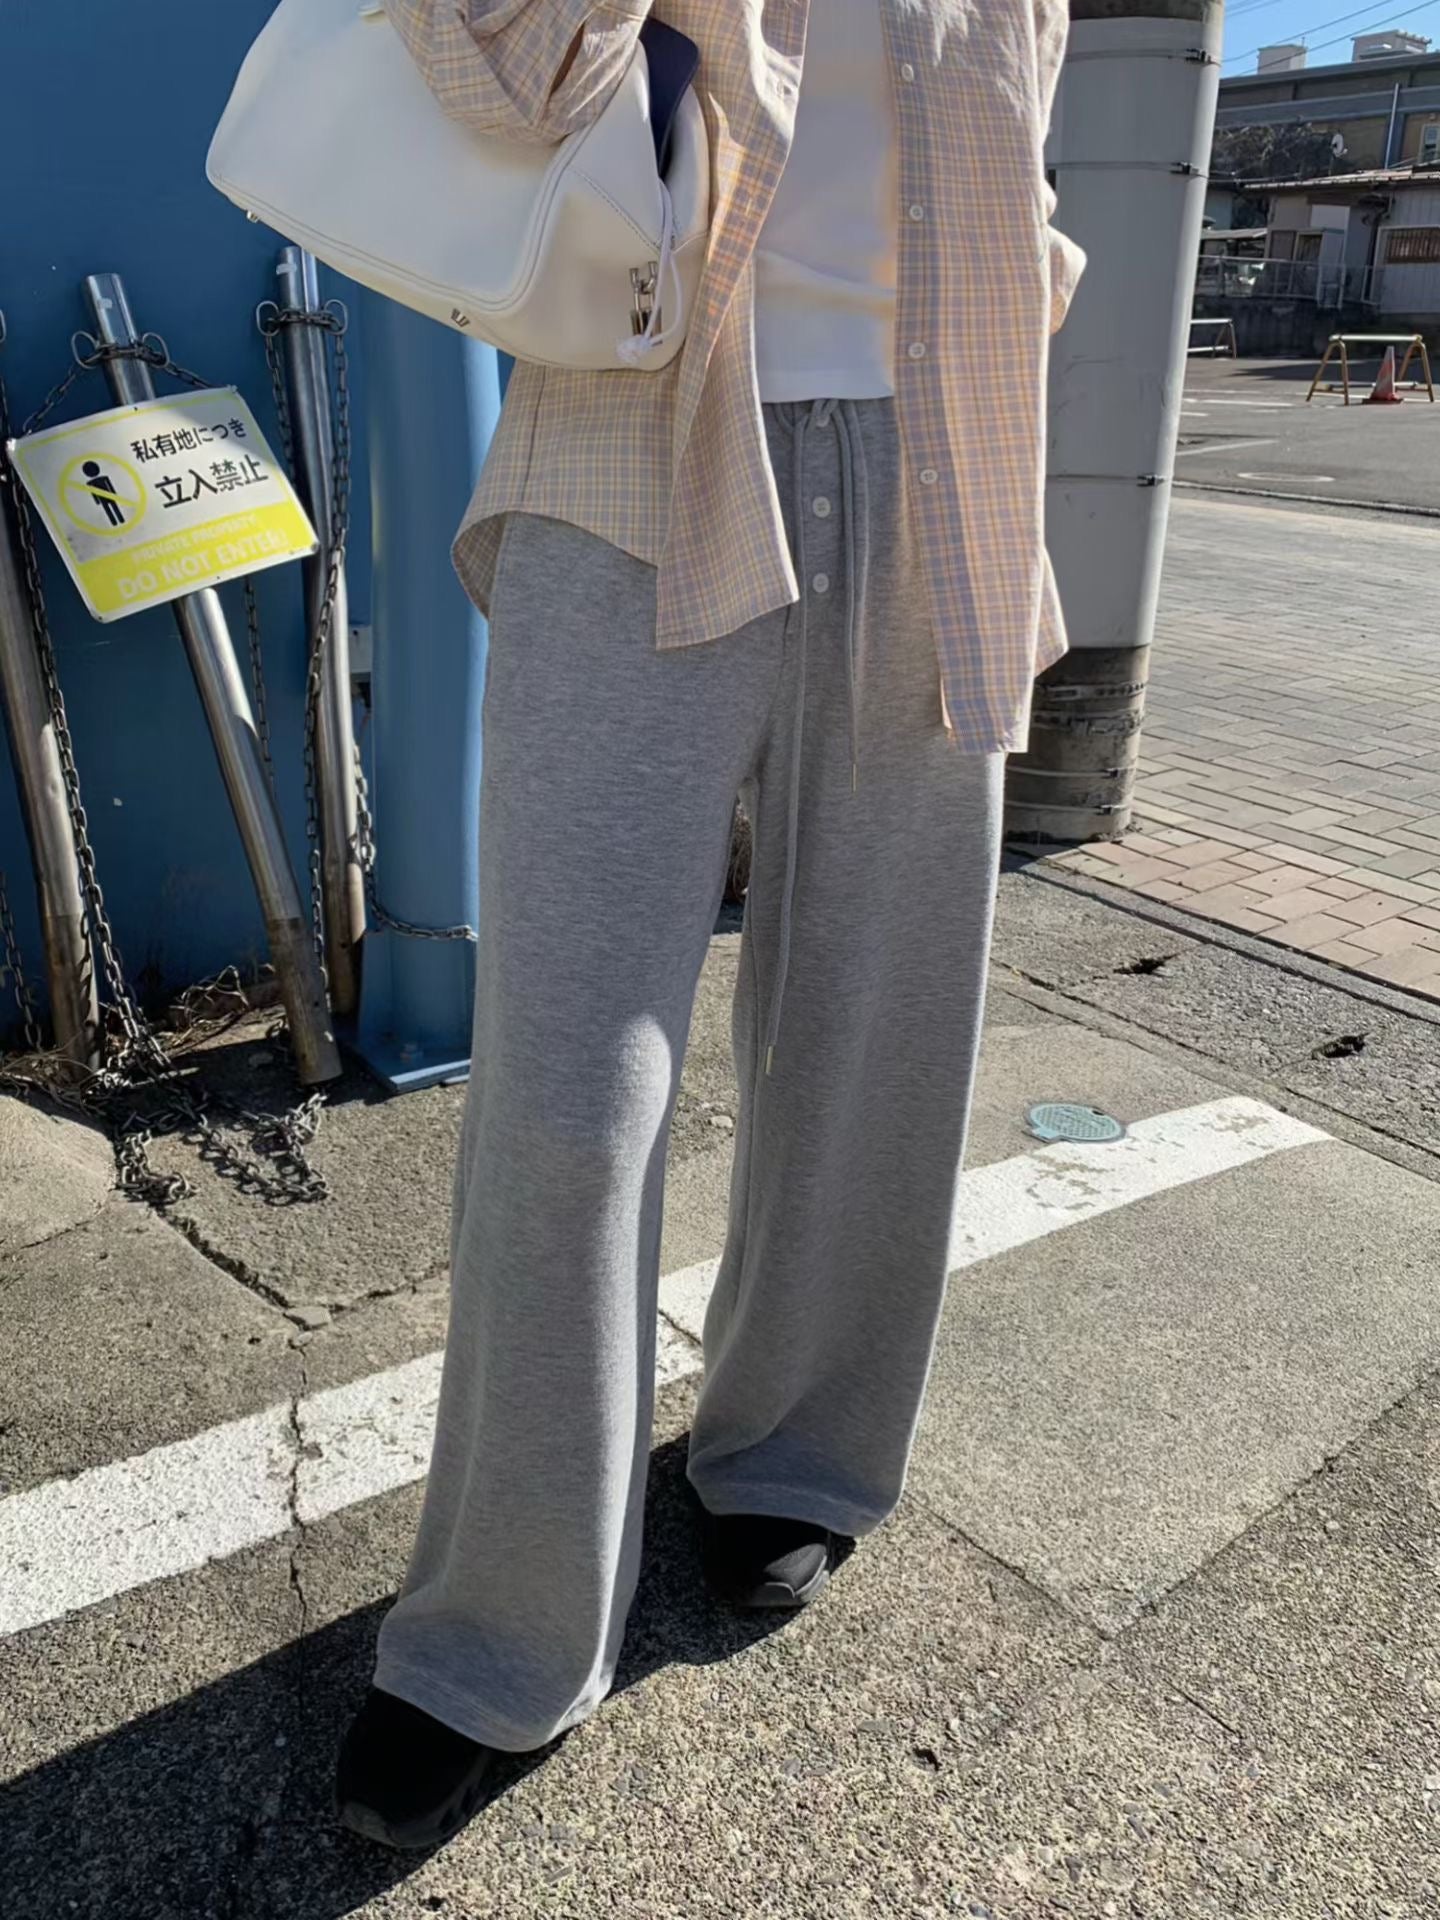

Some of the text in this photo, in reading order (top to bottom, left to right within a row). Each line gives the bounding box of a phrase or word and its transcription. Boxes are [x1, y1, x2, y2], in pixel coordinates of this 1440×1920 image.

[130, 417, 248, 463] 私有地につき
[154, 454, 269, 509] 立入禁止
[117, 570, 157, 599] DO
[161, 549, 212, 583] NOT
